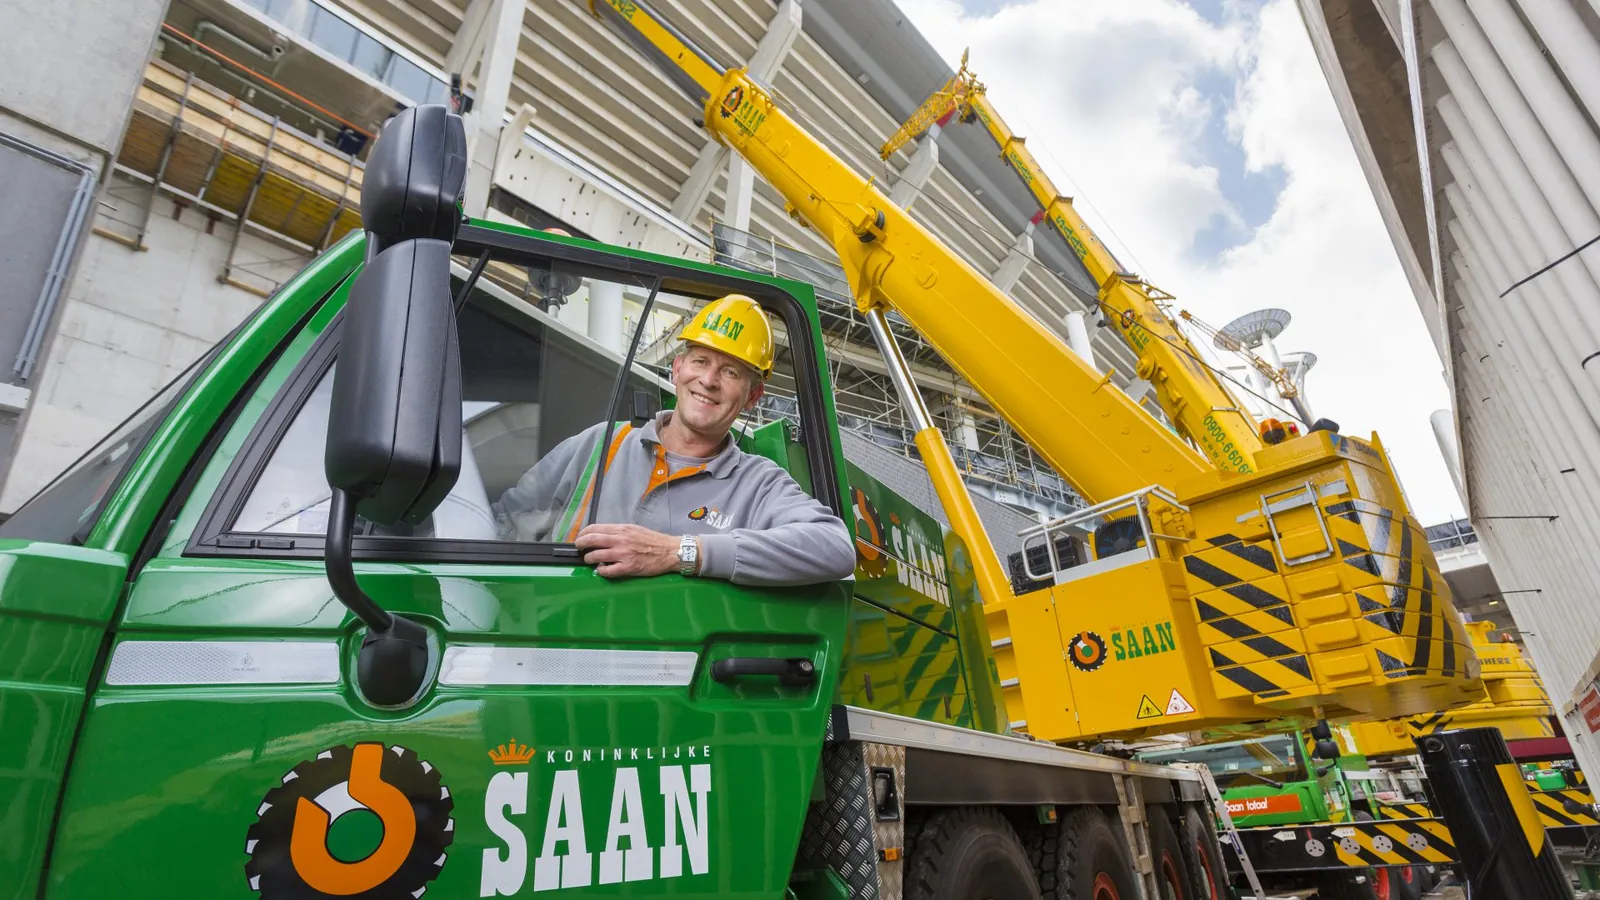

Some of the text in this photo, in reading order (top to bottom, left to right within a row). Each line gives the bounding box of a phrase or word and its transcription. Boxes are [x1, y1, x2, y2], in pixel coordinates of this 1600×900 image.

[1056, 215, 1087, 260] SAAN
[702, 312, 744, 341] SAAN
[892, 525, 951, 608] SAAN
[1111, 621, 1176, 661] SAAN
[547, 745, 710, 763] KONINKLIJKE
[1224, 797, 1268, 813] Saan totaal
[479, 763, 712, 898] SAAN
